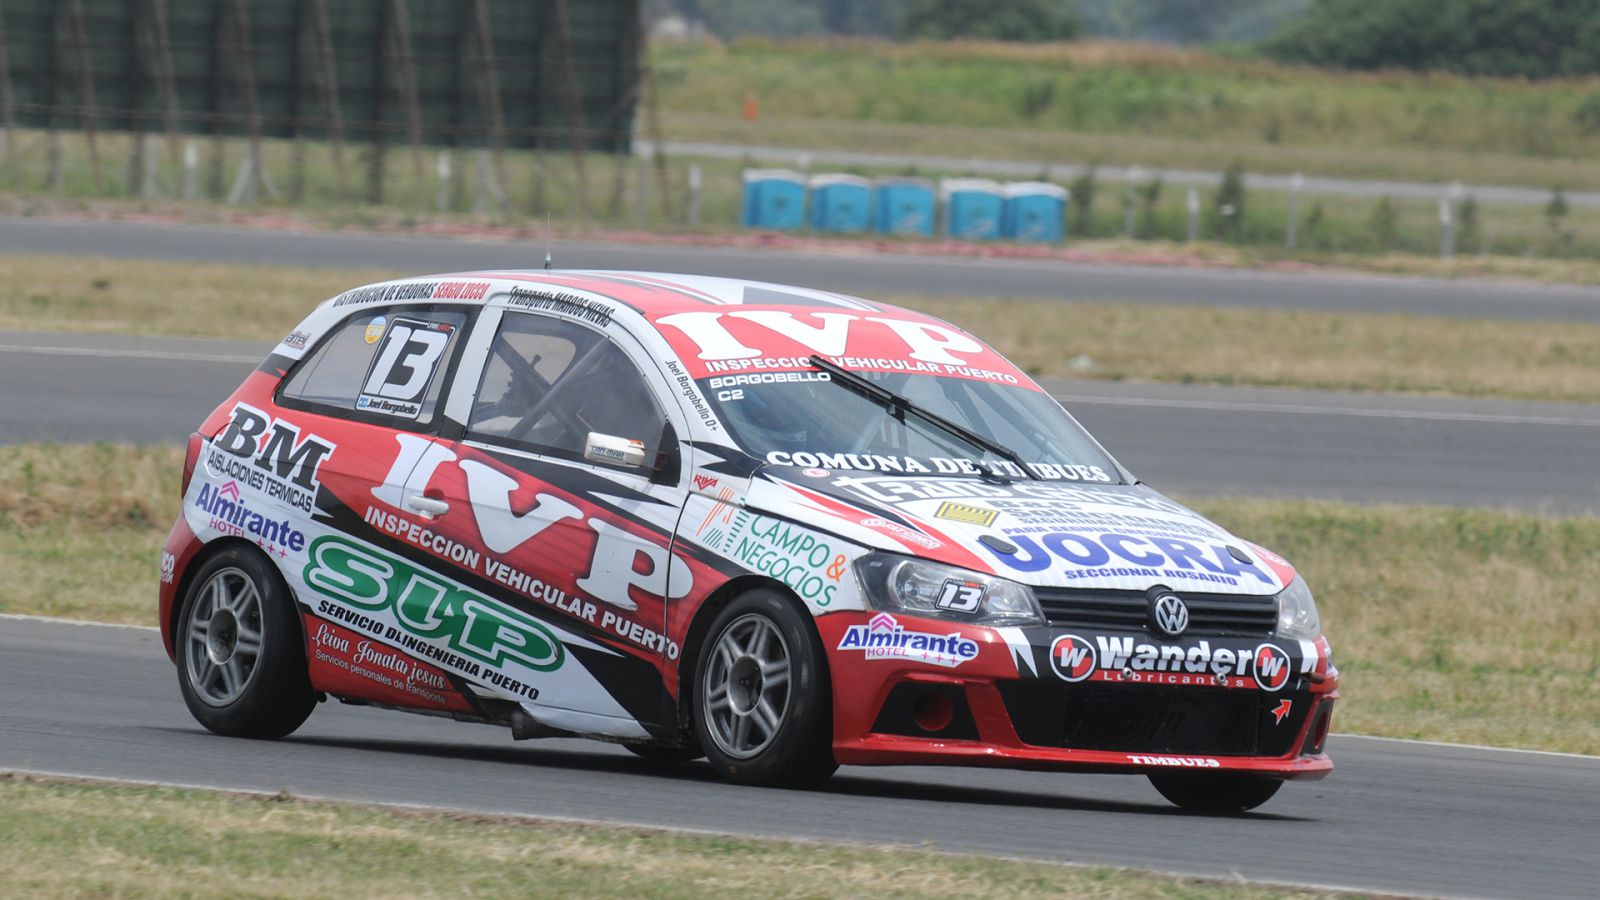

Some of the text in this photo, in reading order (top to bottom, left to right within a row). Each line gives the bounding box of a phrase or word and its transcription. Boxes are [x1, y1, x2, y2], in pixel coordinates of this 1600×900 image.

[433, 282, 466, 299] SERGIO
[656, 310, 984, 367] IVP
[363, 325, 448, 401] 13
[704, 357, 1018, 385] INSPECCIO VEHICULAR PUERTO
[709, 372, 831, 389] BORGOBELLO
[367, 399, 382, 409] Joel
[665, 360, 685, 376] Joel
[676, 375, 710, 420] Borgobello
[717, 389, 744, 401] C2
[211, 403, 336, 493] BM
[766, 450, 929, 476] COMUNA
[929, 457, 982, 475] DE
[207, 451, 313, 513] AISLACIONES TERMICAS
[196, 482, 305, 552] Almirante
[370, 433, 694, 613] IVP
[1001, 526, 1046, 535] PARA
[750, 515, 831, 568] CAMPO
[364, 505, 680, 661] INSPECCION VEHICULAR PUERTO
[734, 536, 838, 607] NEGOCIOS
[1064, 568, 1238, 585] SECCIONAL ROSARIO
[304, 536, 564, 670] SUP
[938, 583, 983, 611] 13
[318, 599, 384, 635] SERVICIO
[481, 668, 540, 701] PUERTO
[841, 628, 977, 658] Almirante
[867, 647, 908, 657] HOTEL
[1096, 636, 1254, 676] Wander
[315, 649, 349, 670] Servicios
[350, 665, 392, 687] personales
[393, 679, 405, 690] de
[1126, 755, 1221, 768] TIMBUES
